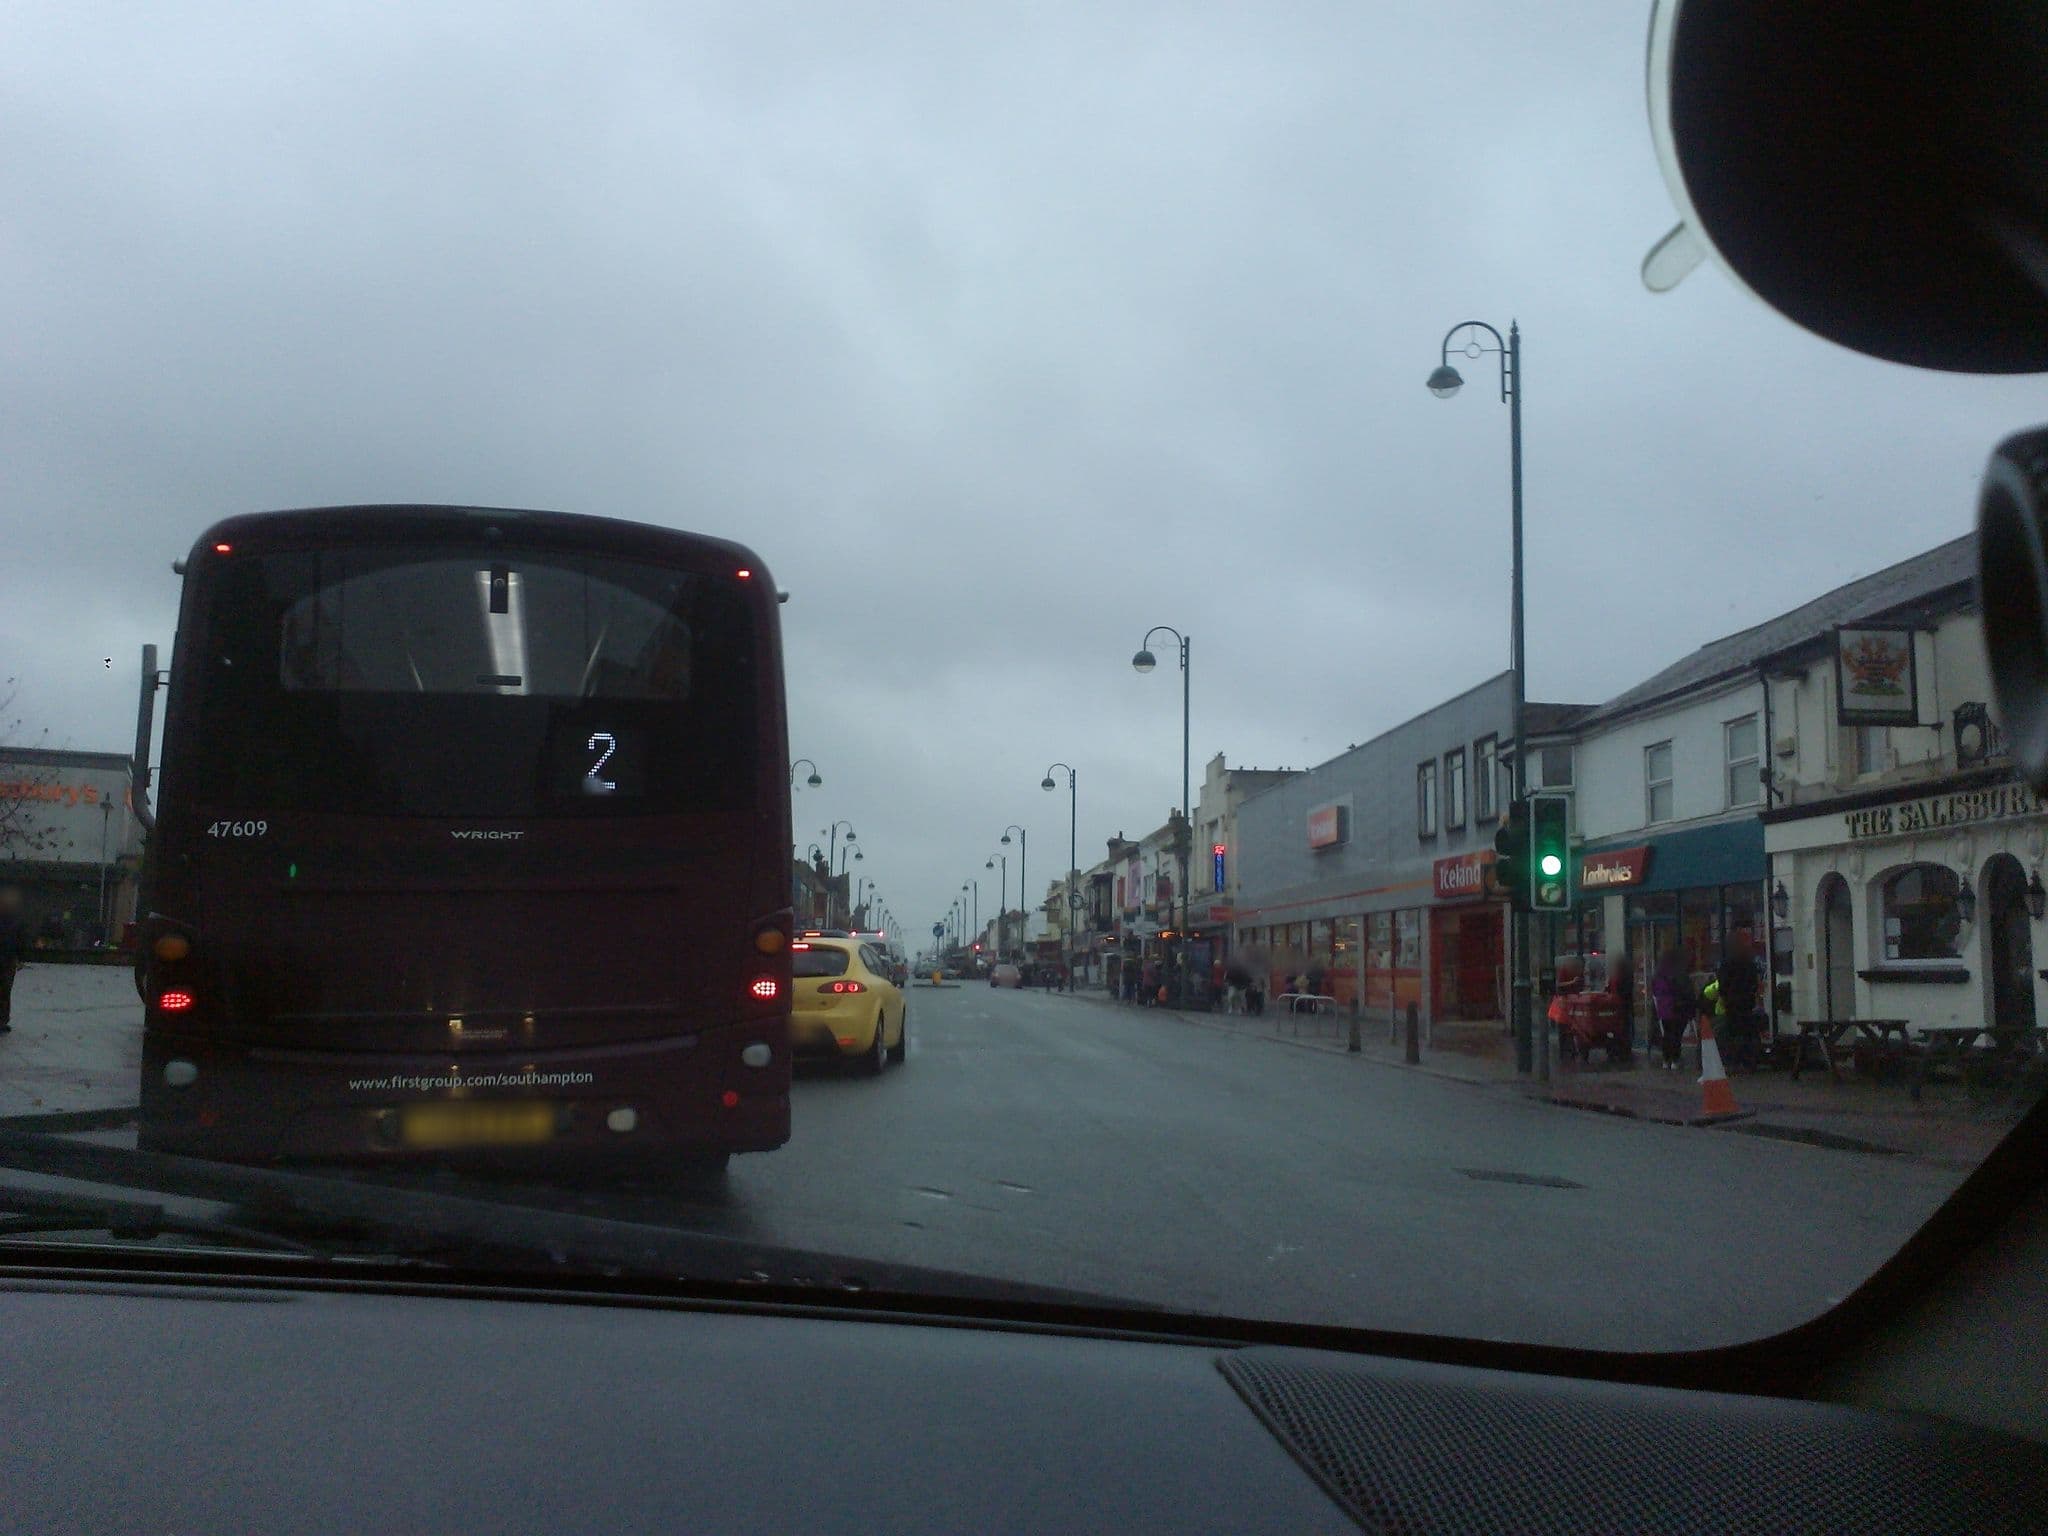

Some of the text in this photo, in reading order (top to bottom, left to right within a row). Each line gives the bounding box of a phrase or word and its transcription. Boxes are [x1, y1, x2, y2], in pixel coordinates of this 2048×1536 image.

[588, 732, 616, 790] 2
[208, 820, 268, 838] 47609
[450, 830, 525, 840] WRIGHT
[1845, 808, 1893, 839] THE
[1440, 863, 1481, 890] Iceland
[349, 1071, 593, 1092] www.firstgroup.com/southampton
